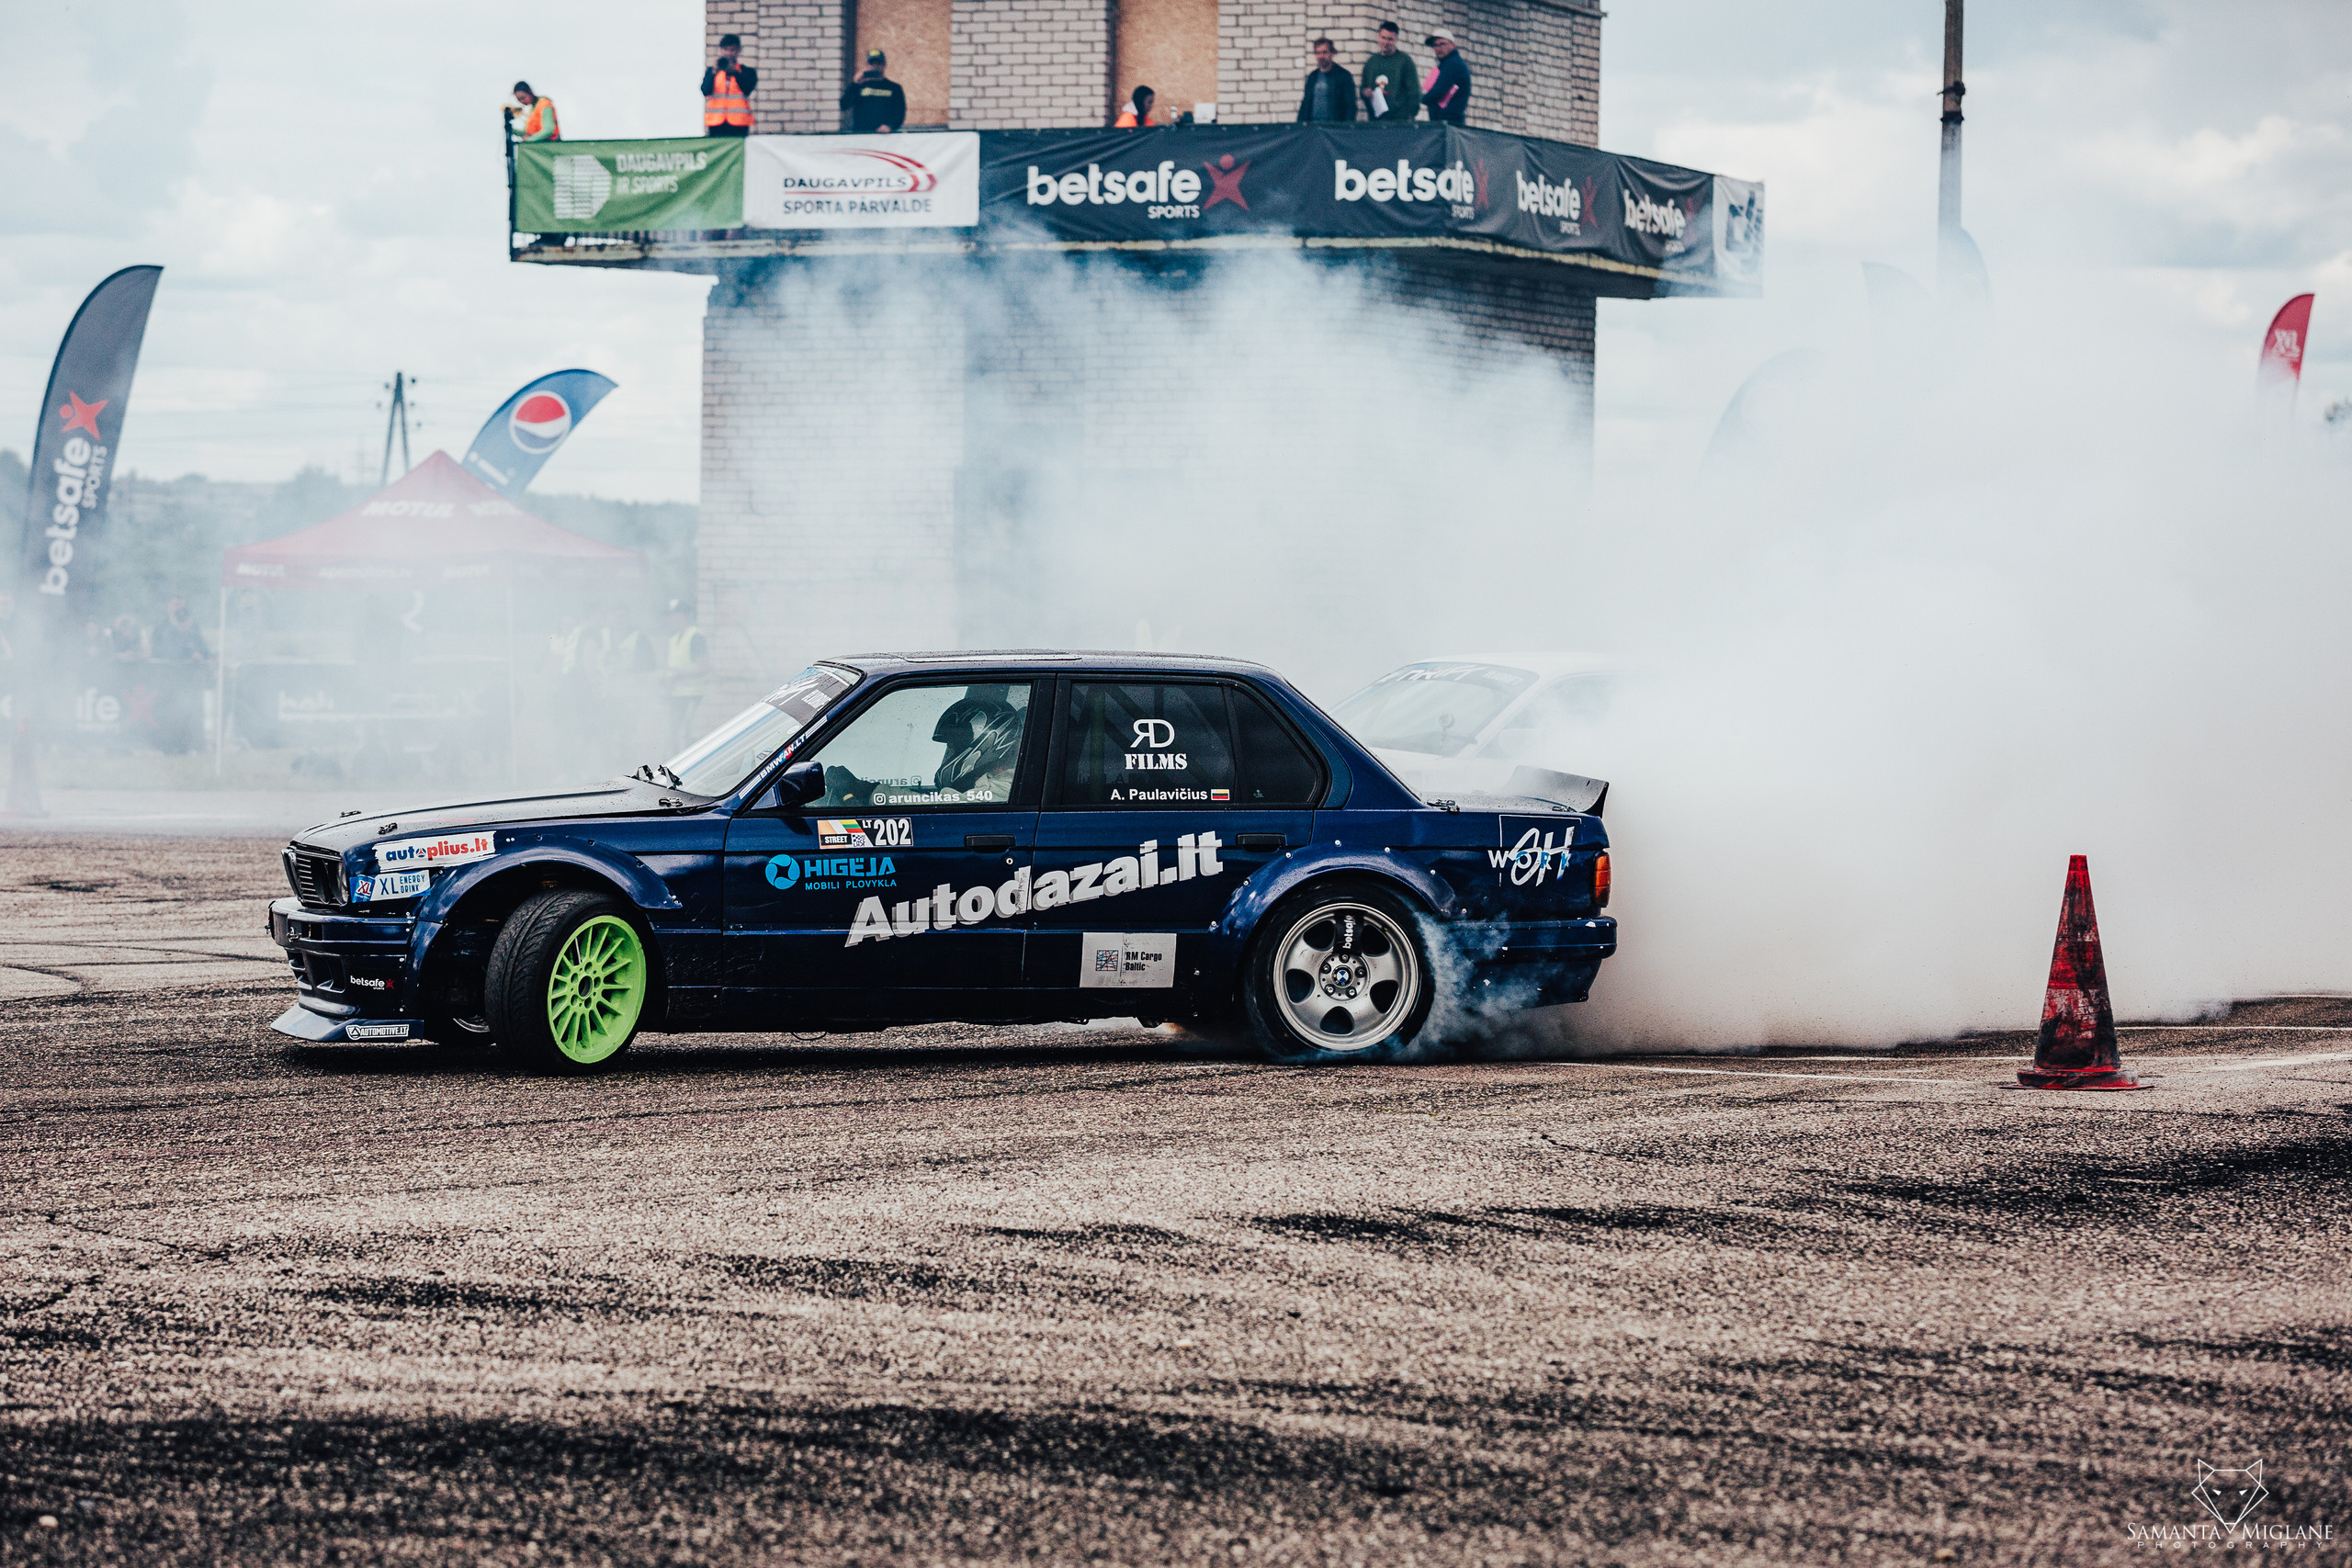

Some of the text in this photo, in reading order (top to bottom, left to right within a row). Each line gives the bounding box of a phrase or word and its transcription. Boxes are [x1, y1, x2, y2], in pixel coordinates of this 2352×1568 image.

[616, 152, 708, 173] DAUGAVPILS
[783, 177, 908, 188] DAUGAVPILS
[1027, 160, 1203, 206] betsafe
[1334, 158, 1475, 205] betsafe
[1516, 170, 1581, 220] betsafe
[784, 200, 843, 214] SPORTA
[1148, 205, 1201, 220] SPORTS
[1623, 188, 1686, 239] betsafe
[82, 445, 107, 510] SPORTS
[40, 436, 92, 596] betsafe
[361, 499, 456, 519] MOTUL
[760, 734, 808, 780] BMWFAN.LT
[1125, 753, 1188, 770] FILMS
[1110, 787, 1208, 801] A. Paulavičius
[824, 835, 848, 844] STREET
[862, 818, 911, 846] LT 202
[386, 838, 488, 862] autoplius.lt
[356, 880, 371, 896] XL
[379, 874, 425, 896] XL ENERGY
[400, 884, 420, 894] DRINK
[805, 879, 897, 890] MOBILI PLOVYKLA
[844, 830, 1224, 947] Autodazai.lt
[1125, 951, 1163, 962] RM Cargo
[1125, 962, 1146, 971] Baltic
[350, 975, 385, 987] betsafe
[360, 1026, 407, 1036] AUTOMOTIVE.LT
